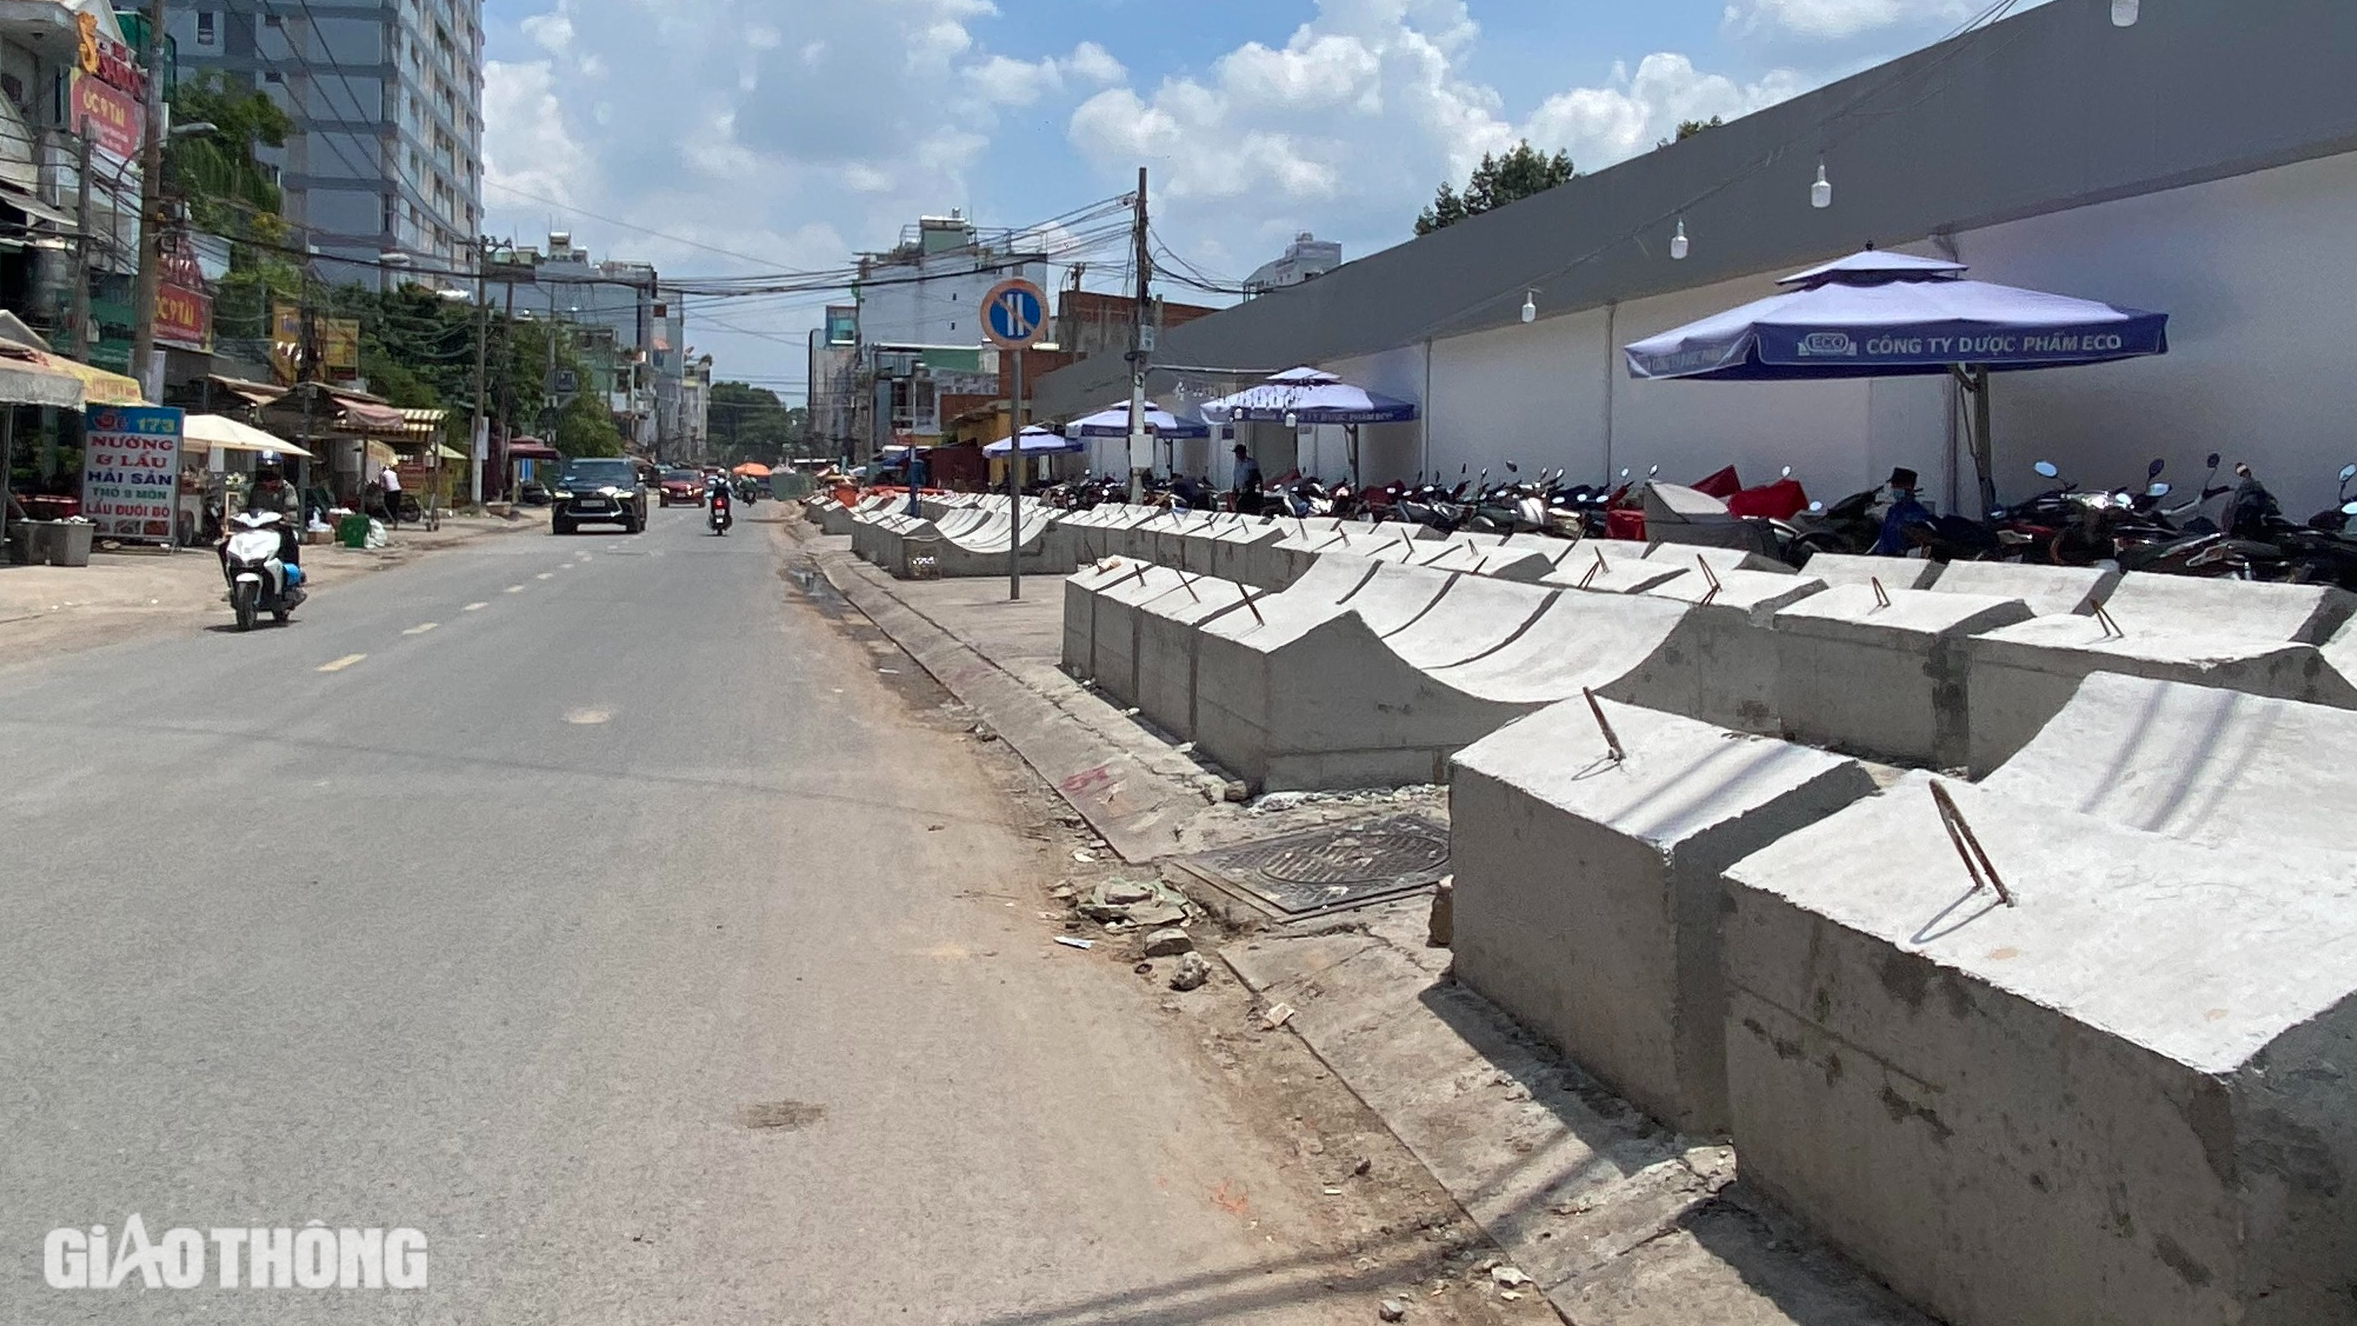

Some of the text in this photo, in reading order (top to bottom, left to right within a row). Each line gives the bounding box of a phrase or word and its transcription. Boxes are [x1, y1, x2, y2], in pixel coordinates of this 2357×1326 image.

[1812, 336, 1843, 349] ECO
[1866, 334, 1922, 354] CÔNG
[1927, 337, 1952, 353] TY
[1959, 334, 2016, 355] DƯỢC
[2082, 334, 2122, 350] ECO
